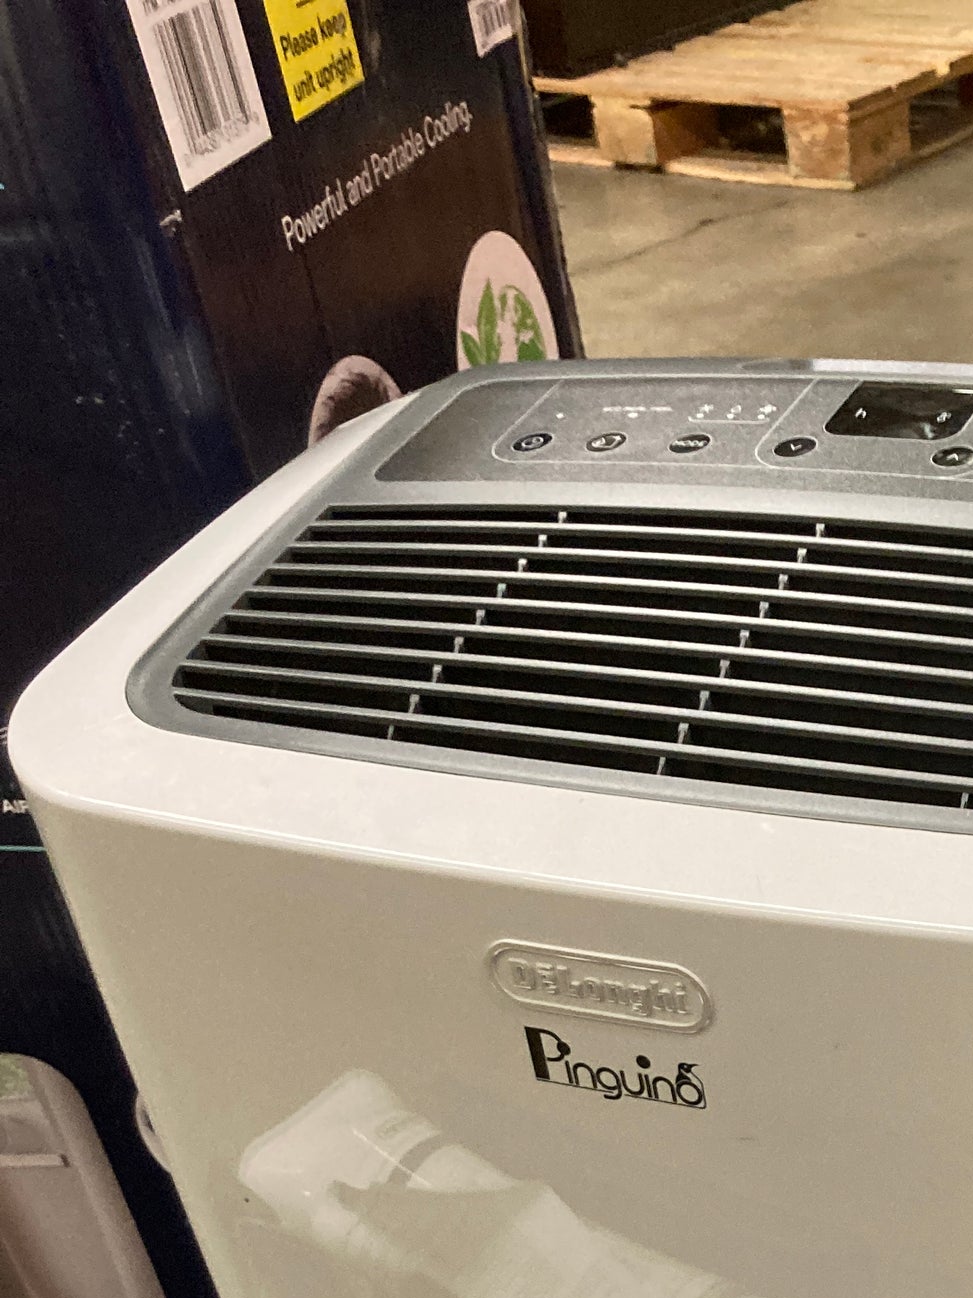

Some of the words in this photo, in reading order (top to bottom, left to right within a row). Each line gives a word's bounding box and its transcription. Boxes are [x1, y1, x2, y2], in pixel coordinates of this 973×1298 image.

[279, 27, 319, 62] Please
[317, 13, 347, 41] keep
[293, 70, 317, 102] unit
[315, 46, 356, 92] upright
[281, 177, 349, 252] Powerful
[346, 158, 374, 206] and
[370, 127, 426, 186] Portable
[523, 1026, 706, 1109] Pinguino
